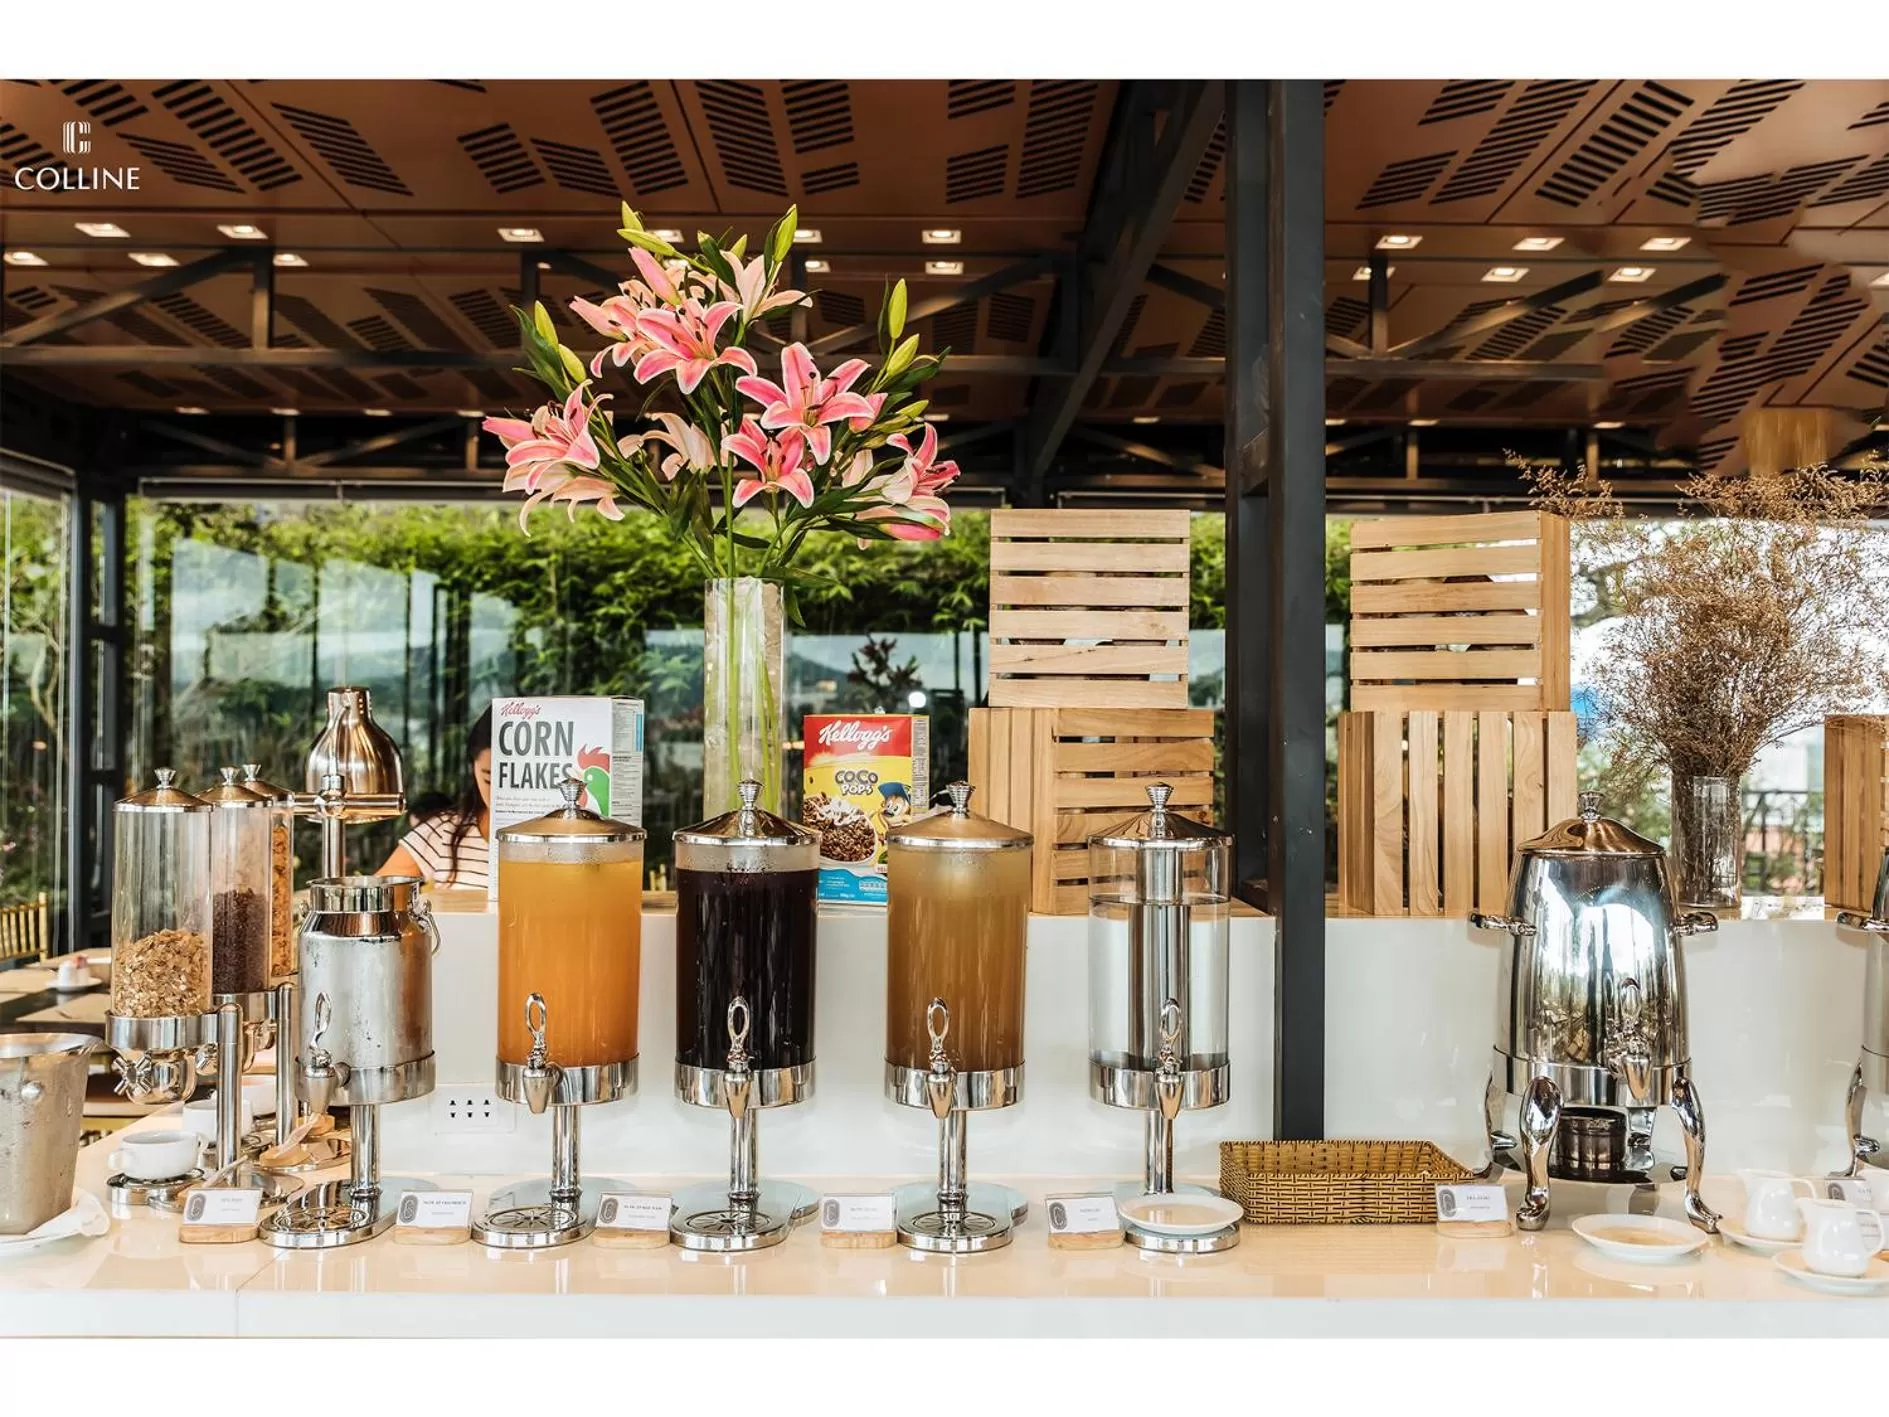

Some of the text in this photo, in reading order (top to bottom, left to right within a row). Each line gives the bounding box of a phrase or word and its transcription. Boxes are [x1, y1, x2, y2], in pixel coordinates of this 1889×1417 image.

[498, 721, 574, 756] CORN
[818, 720, 892, 750] Kellogg's
[835, 769, 879, 785] COCO
[841, 783, 874, 796] POPS
